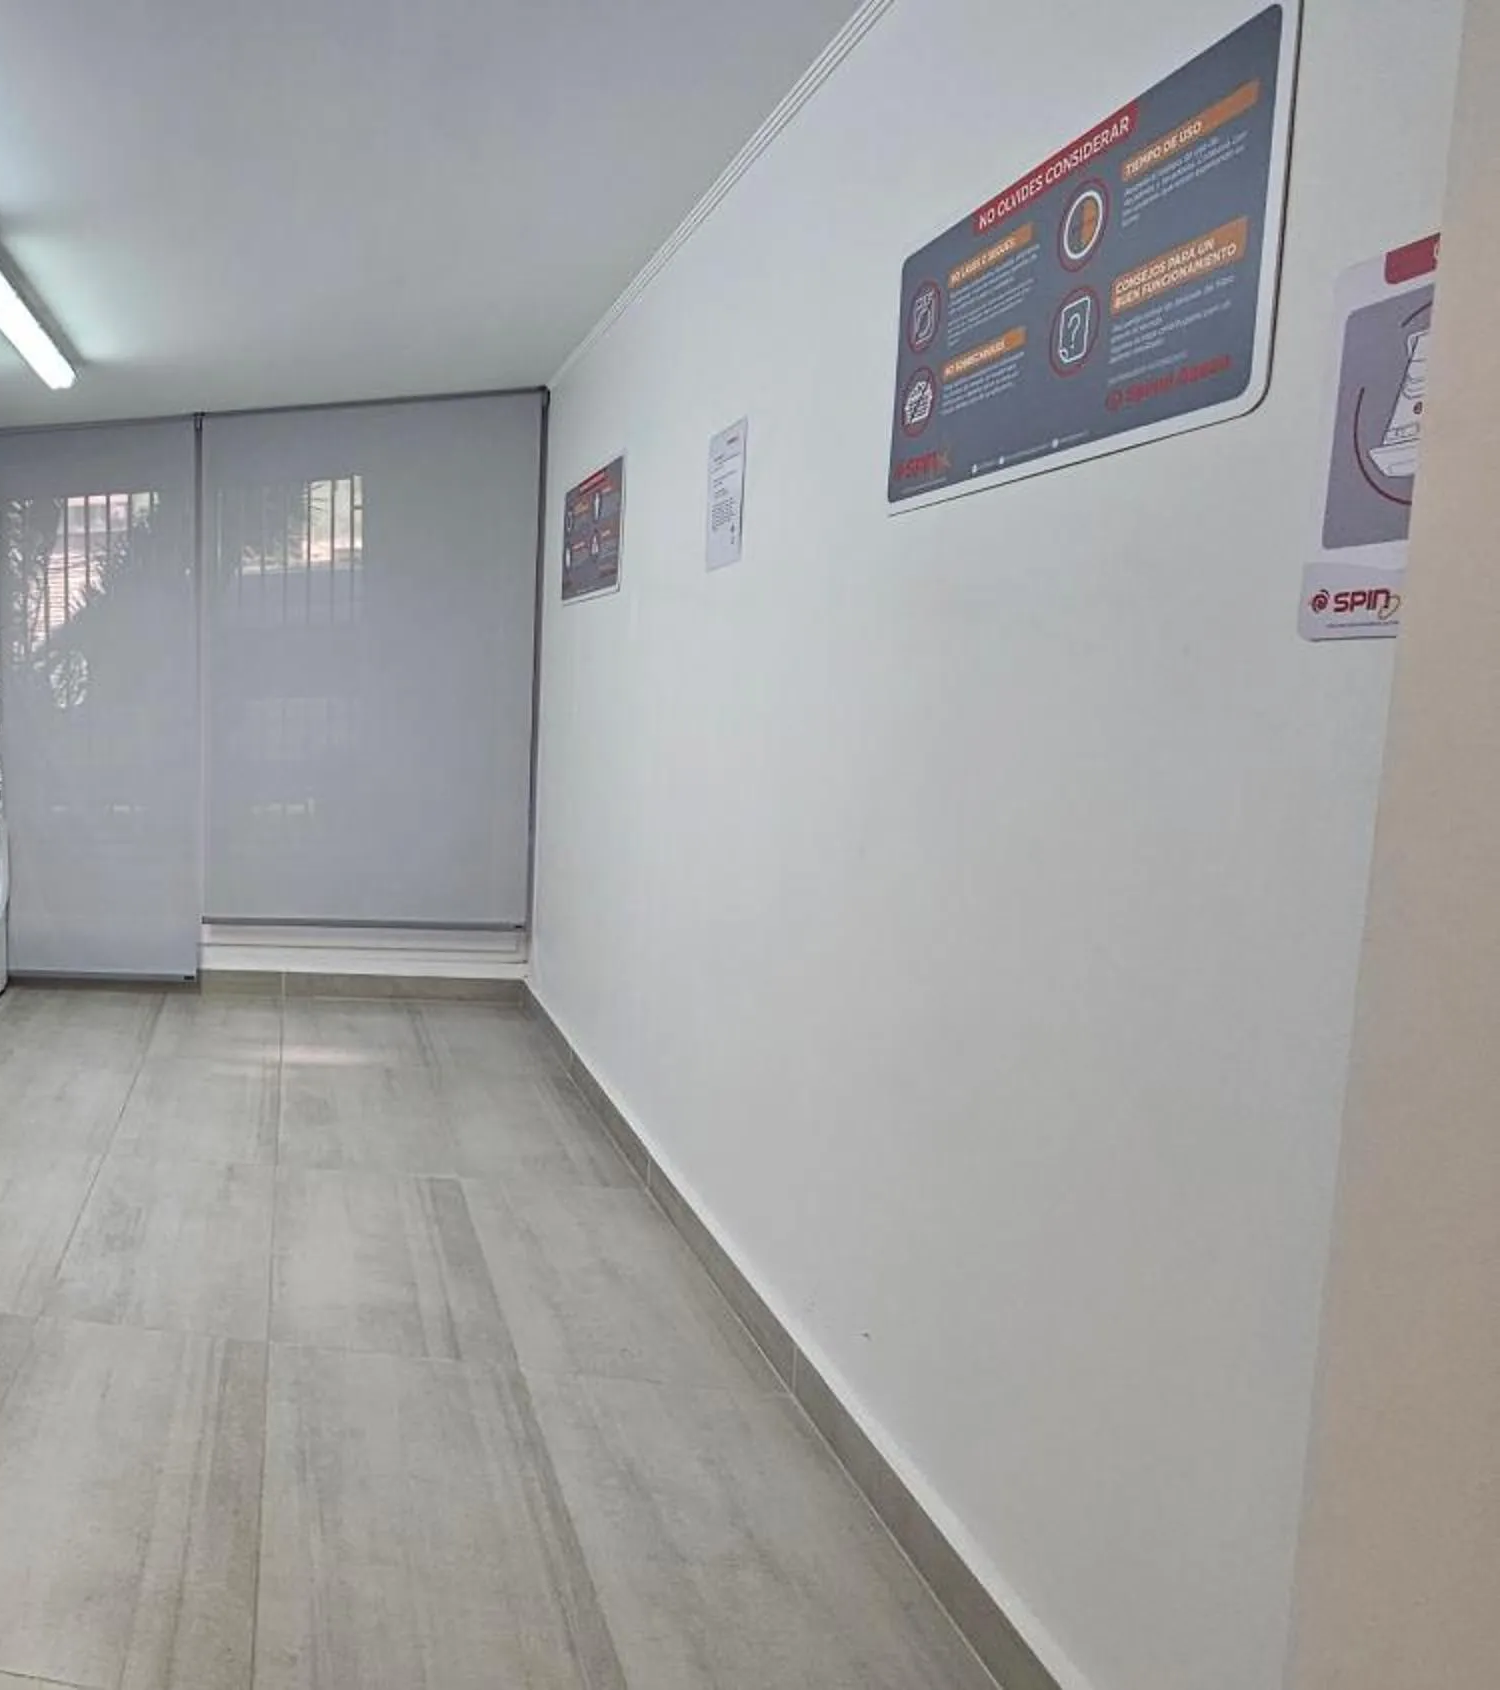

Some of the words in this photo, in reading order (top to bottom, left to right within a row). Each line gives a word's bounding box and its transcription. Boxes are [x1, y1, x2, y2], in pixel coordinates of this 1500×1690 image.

[979, 209, 995, 230] NO
[997, 175, 1043, 217] OLVIDES
[1045, 115, 1130, 184] CONSIDERAR
[1125, 145, 1161, 176] TIEMPO
[1164, 135, 1178, 153] DE
[1180, 120, 1203, 144] USO
[1116, 260, 1166, 295] CONSEJOS
